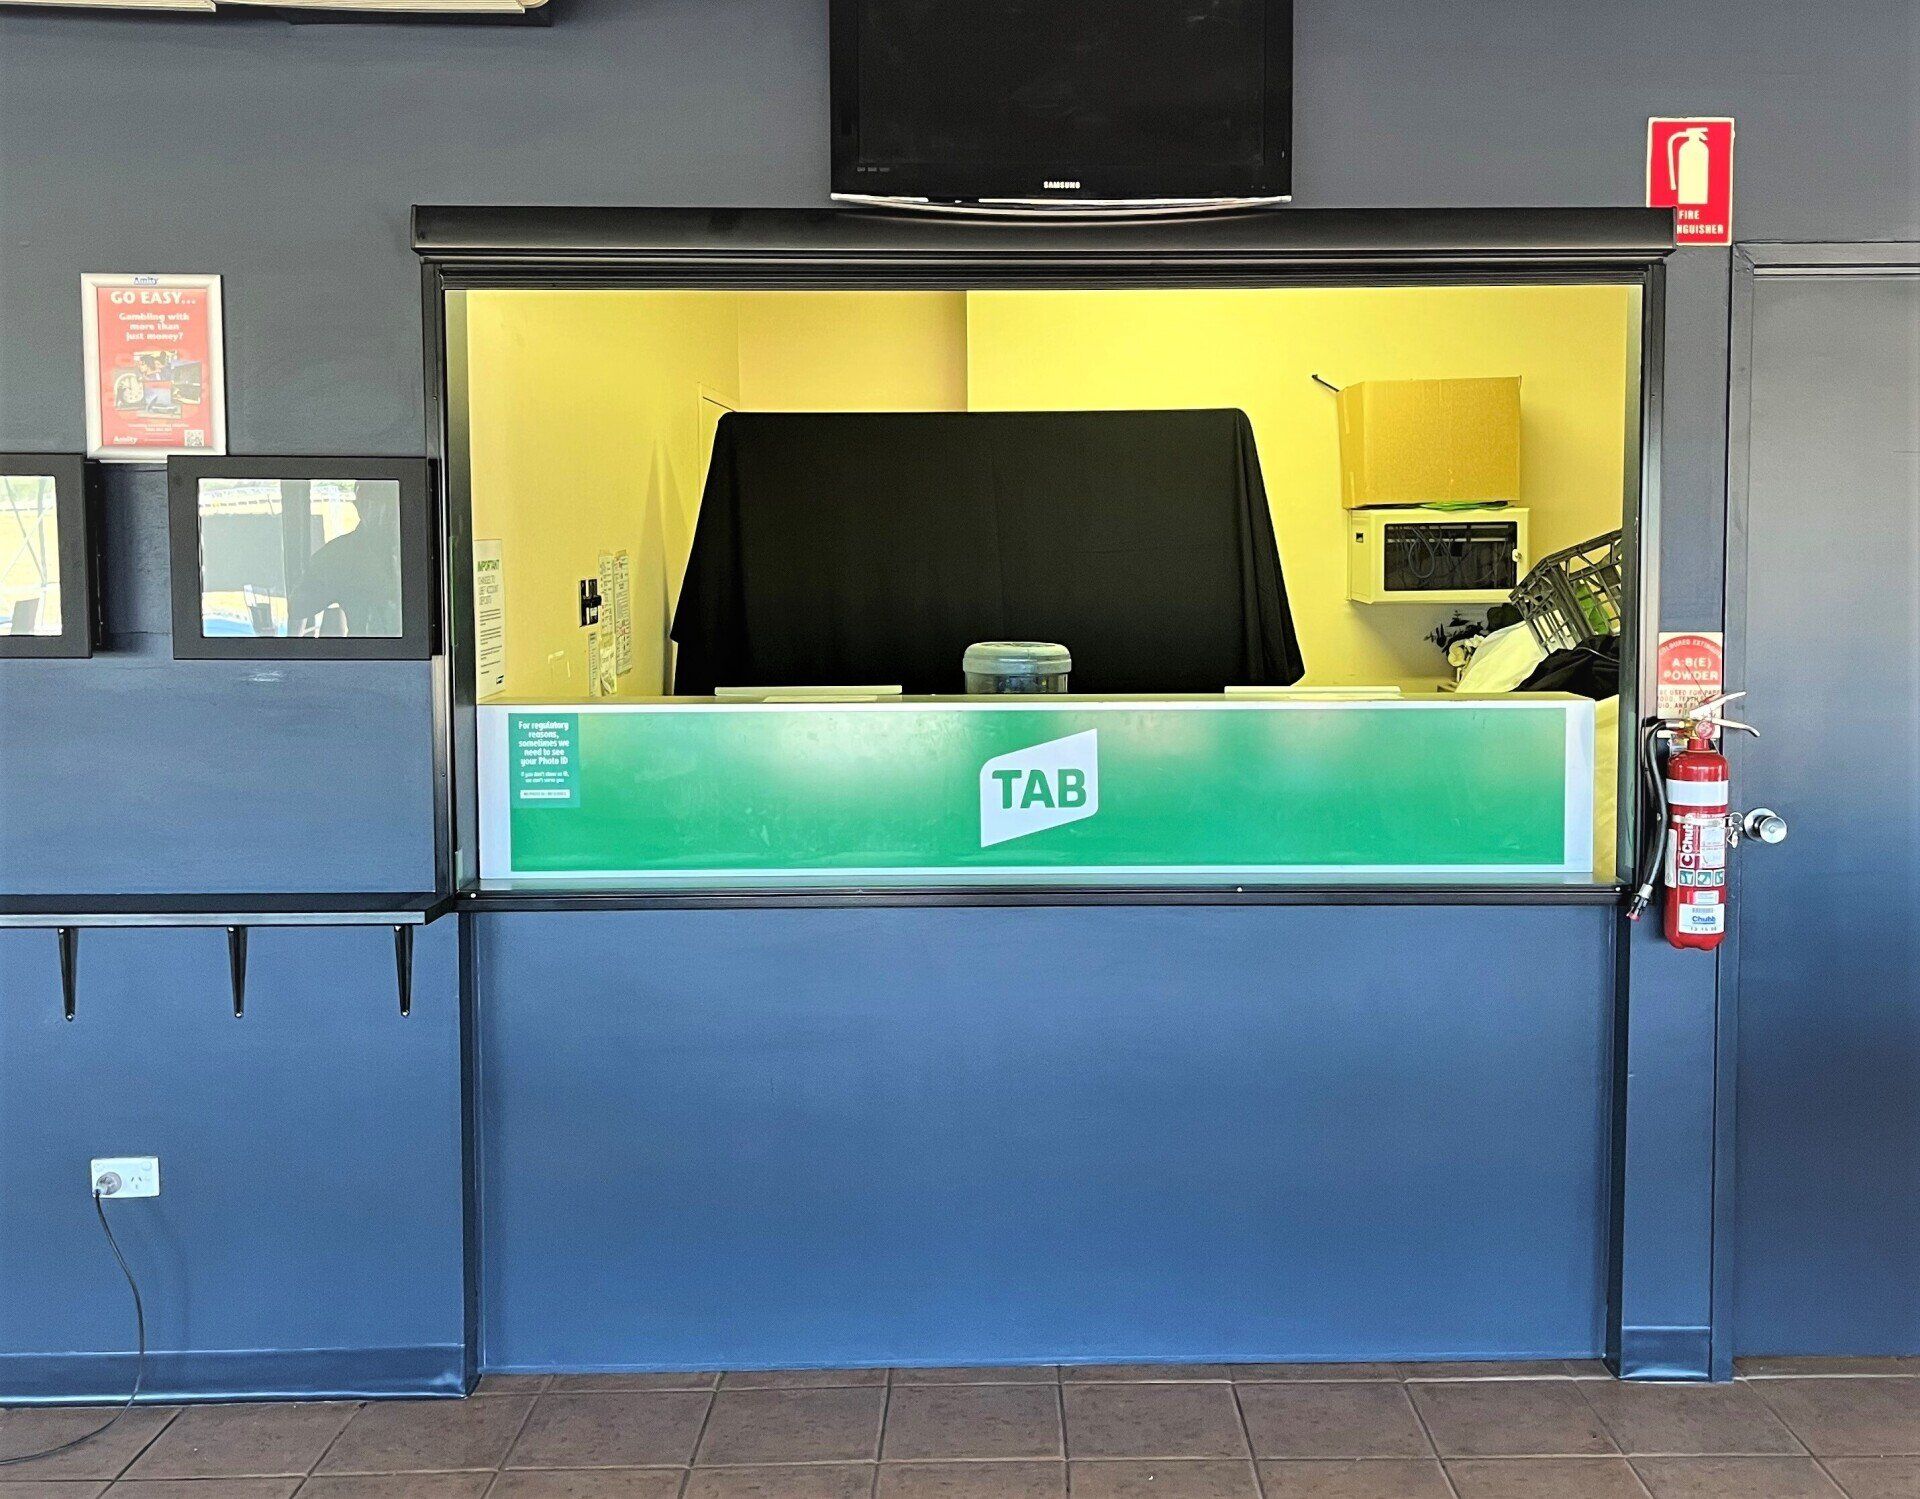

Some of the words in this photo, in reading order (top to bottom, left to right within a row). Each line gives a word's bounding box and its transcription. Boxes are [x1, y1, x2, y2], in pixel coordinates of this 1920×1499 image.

[1043, 181, 1081, 189] SAMSUNG
[1679, 210, 1700, 220] FIRE
[1676, 224, 1724, 234] NGUISHER
[110, 291, 135, 305] GO
[140, 291, 197, 305] EASY...
[119, 312, 166, 323] Gambling
[168, 312, 190, 322] with
[158, 322, 180, 330] than
[126, 332, 144, 342] just
[146, 332, 184, 342] money?
[1663, 670, 1718, 680] POWDER
[518, 721, 530, 730] For
[532, 721, 569, 731] regulatory
[528, 731, 559, 739] reasons,
[518, 738, 558, 748] sometimes
[524, 748, 542, 756] need
[542, 748, 551, 756] to
[520, 758, 538, 767] your
[538, 757, 560, 765] Photo
[560, 756, 568, 765] ID
[992, 768, 1087, 809] TAB
